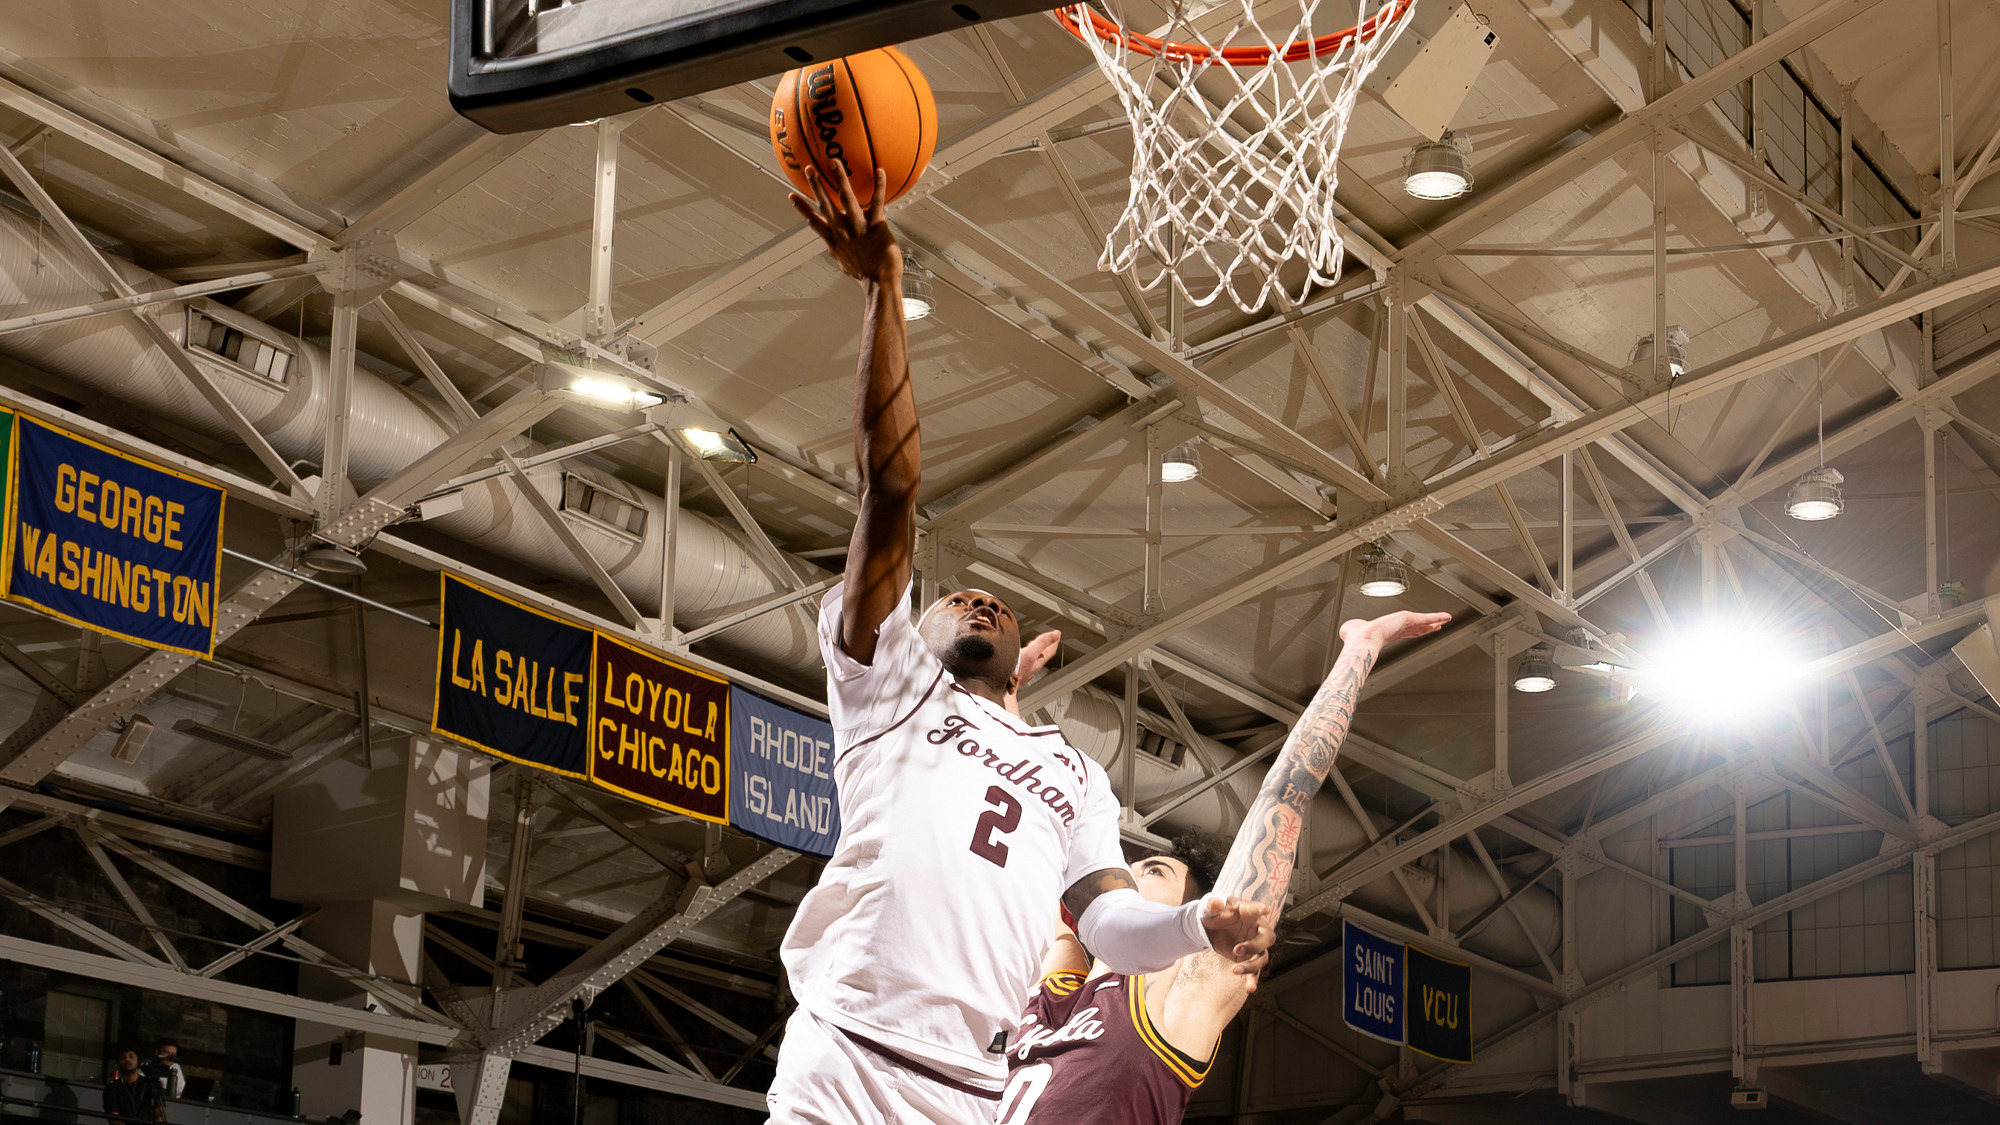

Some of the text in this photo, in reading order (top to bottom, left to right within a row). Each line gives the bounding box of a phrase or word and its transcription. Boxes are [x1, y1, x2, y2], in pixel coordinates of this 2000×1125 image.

[54, 462, 186, 551] GEORGE
[21, 522, 211, 628] WASHINGTON
[451, 628, 584, 727] LA SALLE
[603, 661, 718, 743] LOYOLA
[598, 717, 721, 796] CHICAGO
[749, 715, 830, 780] RHODE
[926, 714, 1076, 828] Fordham
[743, 771, 832, 836] ISLAND
[968, 785, 1023, 869] 2
[1354, 943, 1395, 986] SAINT
[1354, 981, 1396, 1025] LOUIS
[1422, 984, 1459, 1029] VCU
[417, 1067, 455, 1089] ION 2
